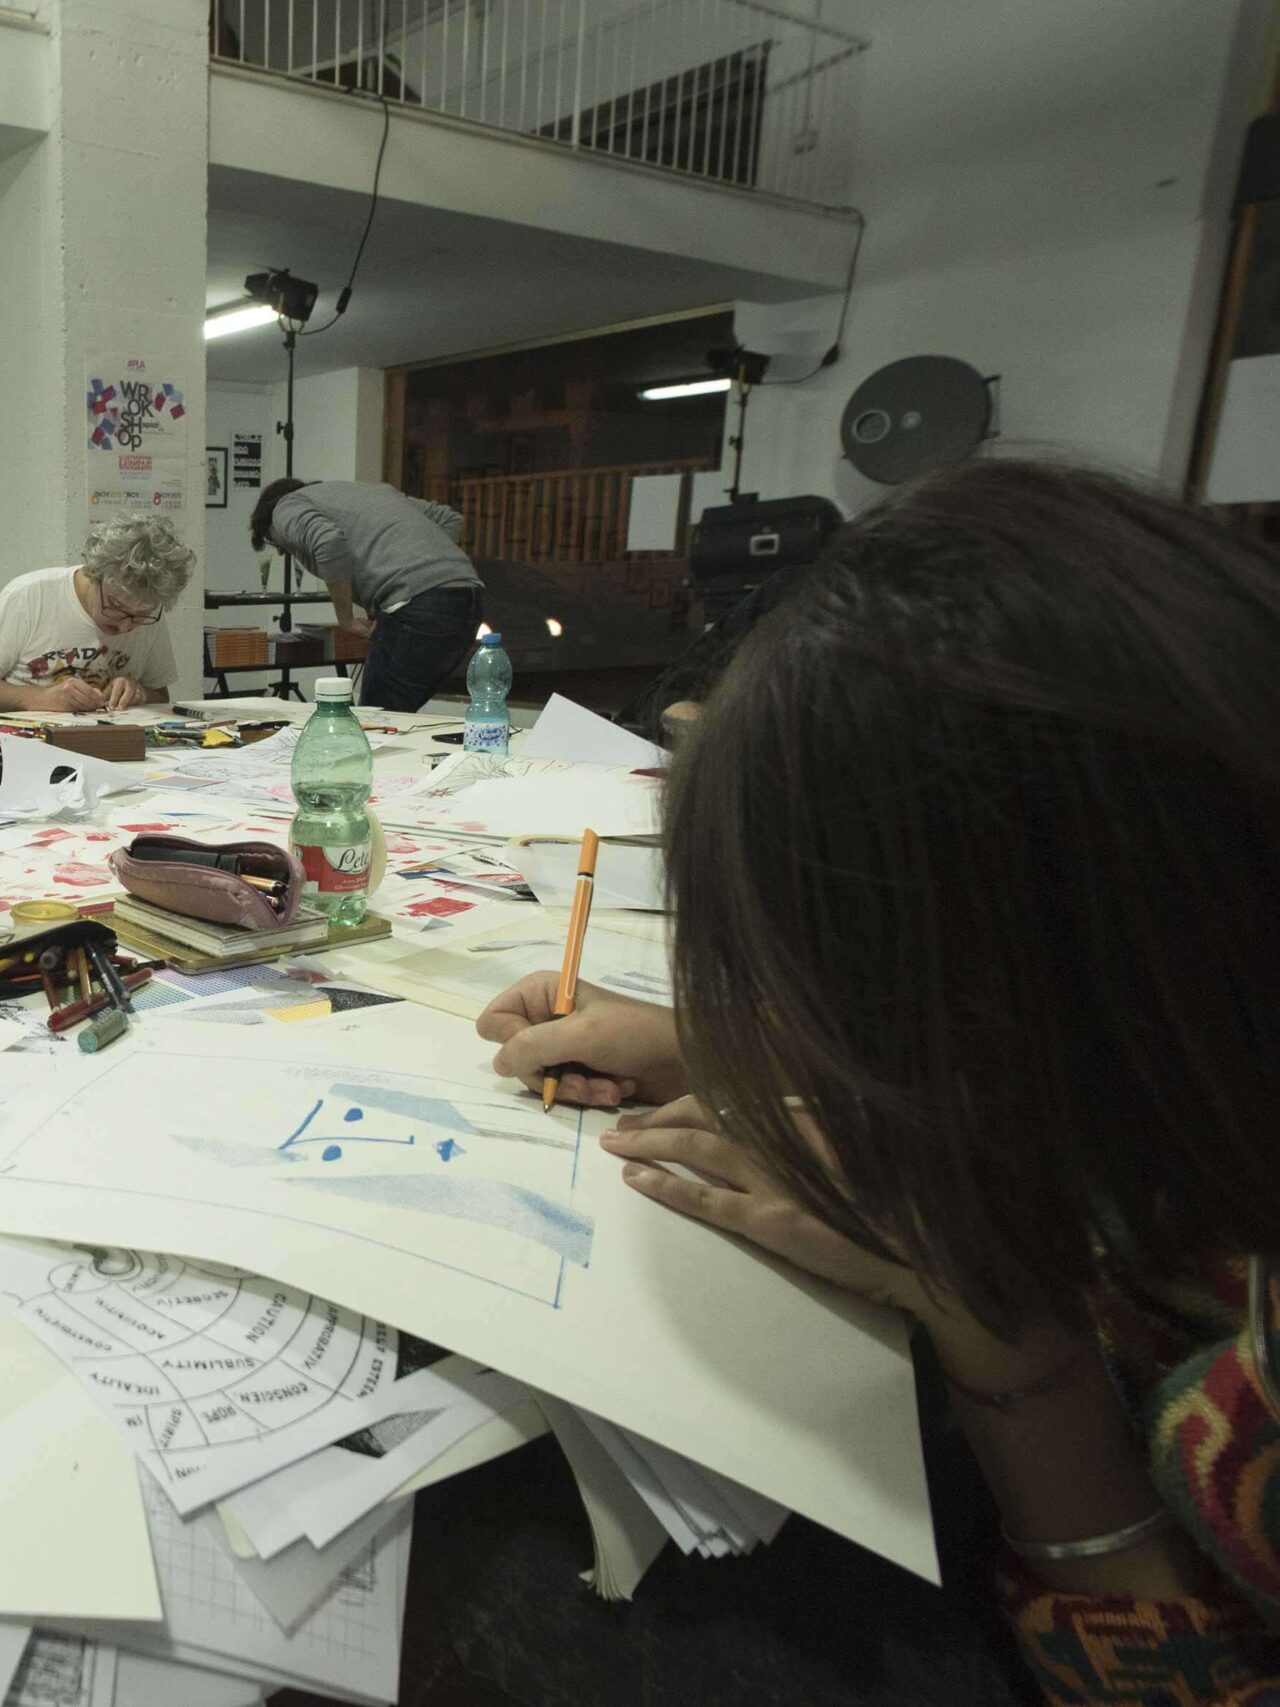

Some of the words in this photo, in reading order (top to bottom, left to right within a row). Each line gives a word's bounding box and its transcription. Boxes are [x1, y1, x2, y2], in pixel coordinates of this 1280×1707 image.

[246, 1292, 286, 1343] CAUTION
[161, 1356, 256, 1370] SUBLIMITY
[89, 1371, 160, 1396] IDEALITY
[202, 1404, 237, 1424] HOPE
